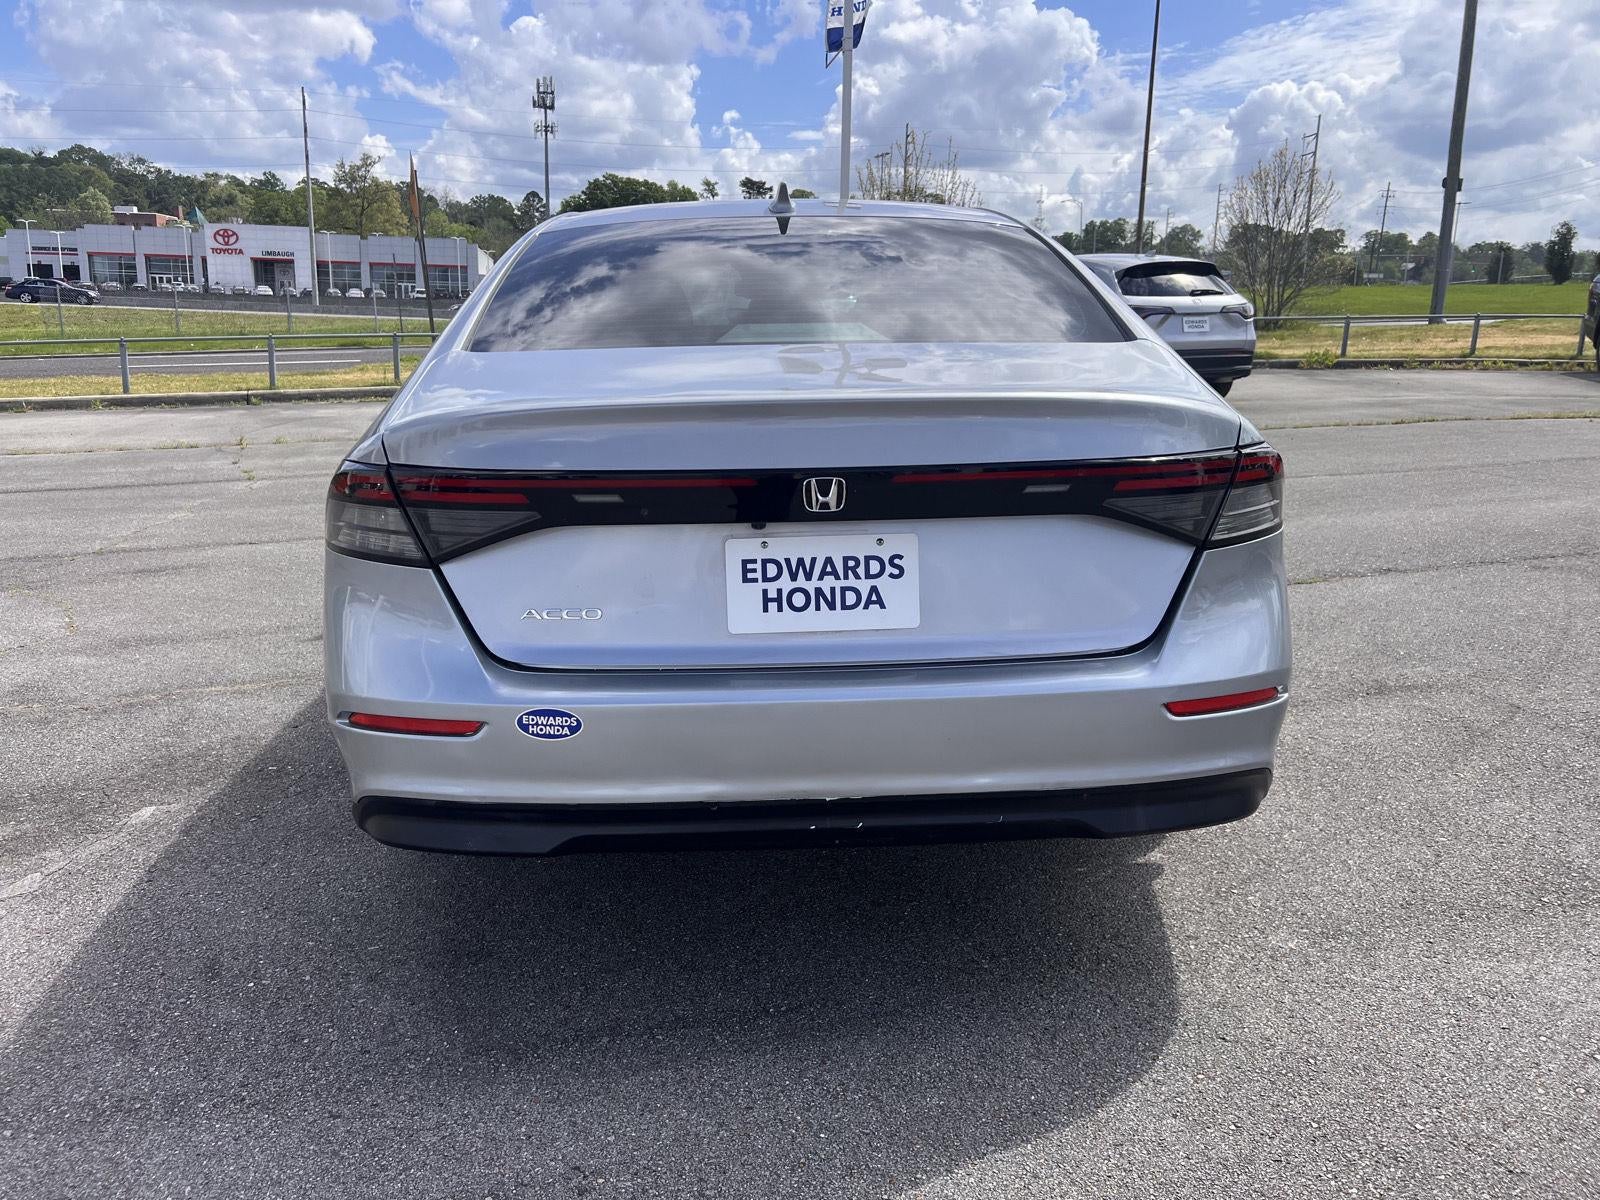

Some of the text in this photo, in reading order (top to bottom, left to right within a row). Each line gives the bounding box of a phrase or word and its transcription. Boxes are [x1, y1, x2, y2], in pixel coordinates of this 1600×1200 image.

[210, 247, 244, 256] TOYOTA
[741, 553, 905, 584] EDWARDS
[761, 585, 887, 613] HONDA
[520, 608, 603, 621] ACCO
[522, 715, 577, 726] EDWARDS
[528, 725, 571, 736] HONDA
